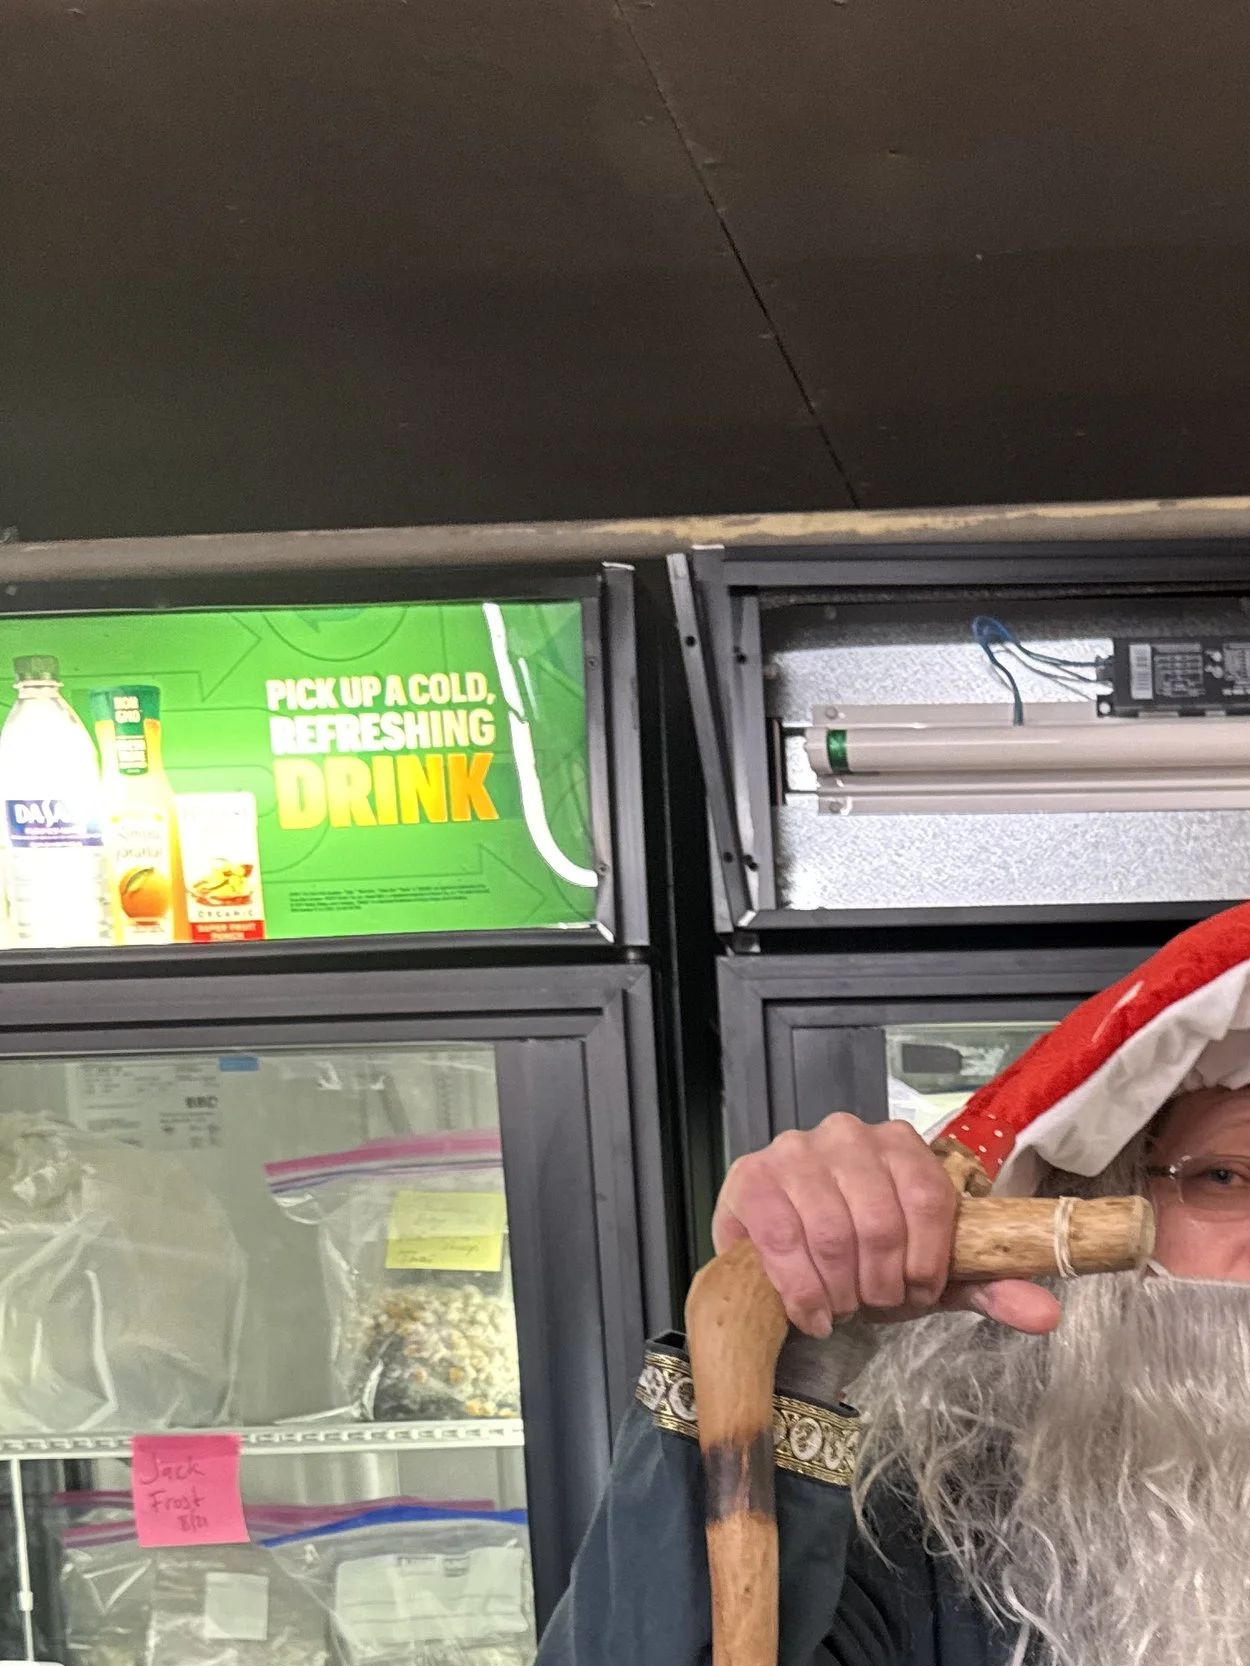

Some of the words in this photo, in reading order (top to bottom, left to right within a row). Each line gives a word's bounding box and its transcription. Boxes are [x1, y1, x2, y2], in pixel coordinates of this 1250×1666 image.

[265, 677, 339, 711] PICK
[339, 675, 382, 708] UP
[384, 674, 408, 706] A
[407, 671, 496, 705] COLD,
[269, 708, 497, 756] REFRESHING
[273, 752, 500, 830] DRINK
[14, 801, 86, 828] DASA
[140, 1450, 205, 1485] Jack
[148, 1485, 205, 1514] Frost
